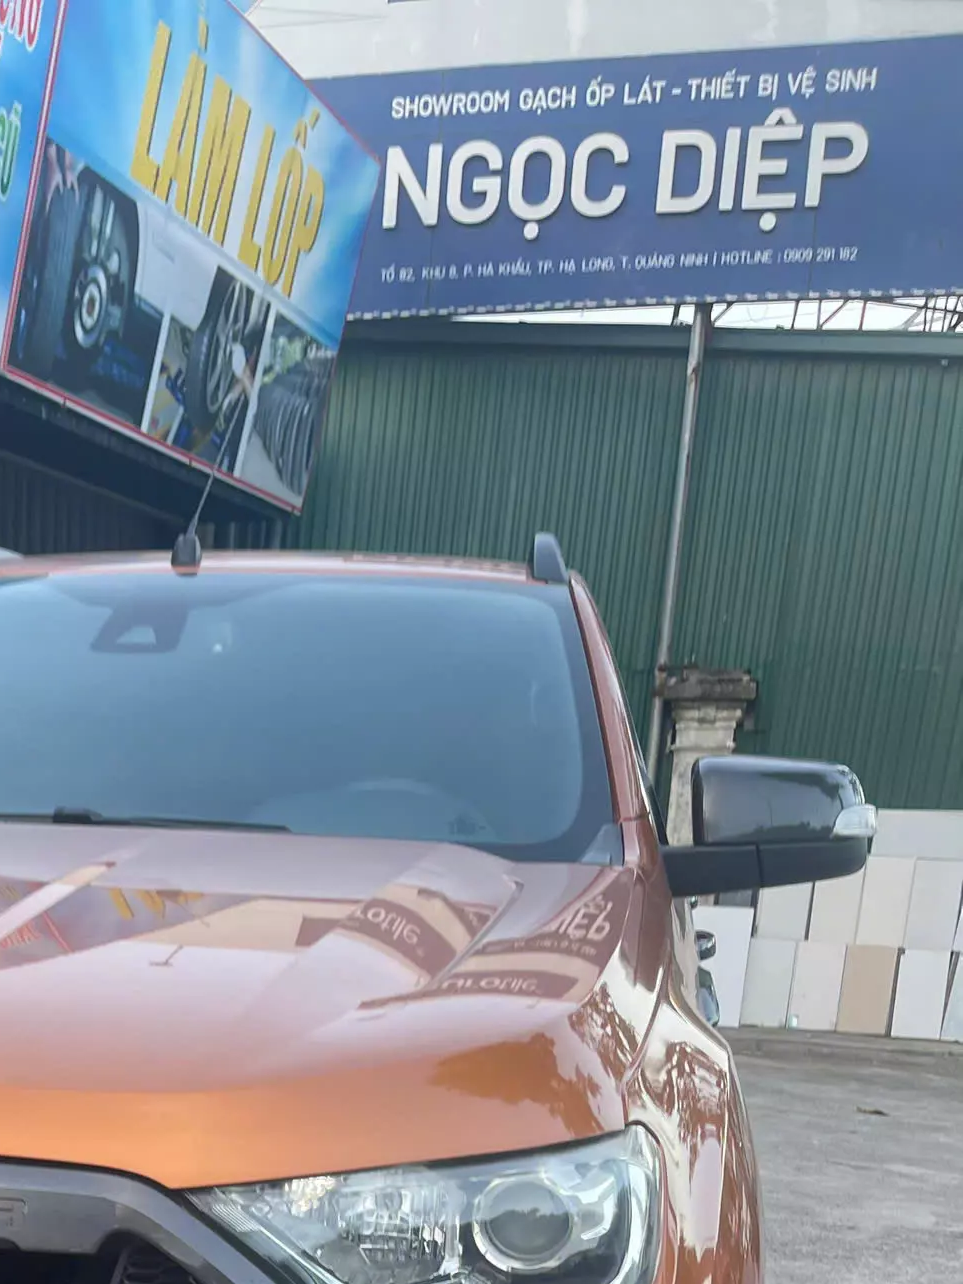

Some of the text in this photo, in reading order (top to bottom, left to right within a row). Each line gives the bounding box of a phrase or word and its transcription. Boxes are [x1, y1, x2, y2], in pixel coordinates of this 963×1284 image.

[391, 89, 511, 119] SHOWROOM
[519, 85, 576, 115] GẠCH
[586, 75, 615, 107] ỐP
[623, 74, 667, 105] LÁT
[688, 68, 751, 101] THIẾT
[758, 73, 778, 100] BỊ
[787, 64, 817, 99] VỆ
[825, 67, 878, 92] SINH
[130, 15, 325, 299] LÀM LỐP
[382, 107, 870, 241] NGỌC DIỆP
[421, 264, 446, 280] KHU
[680, 252, 708, 267] NINH
[721, 249, 773, 266] HOTLINE
